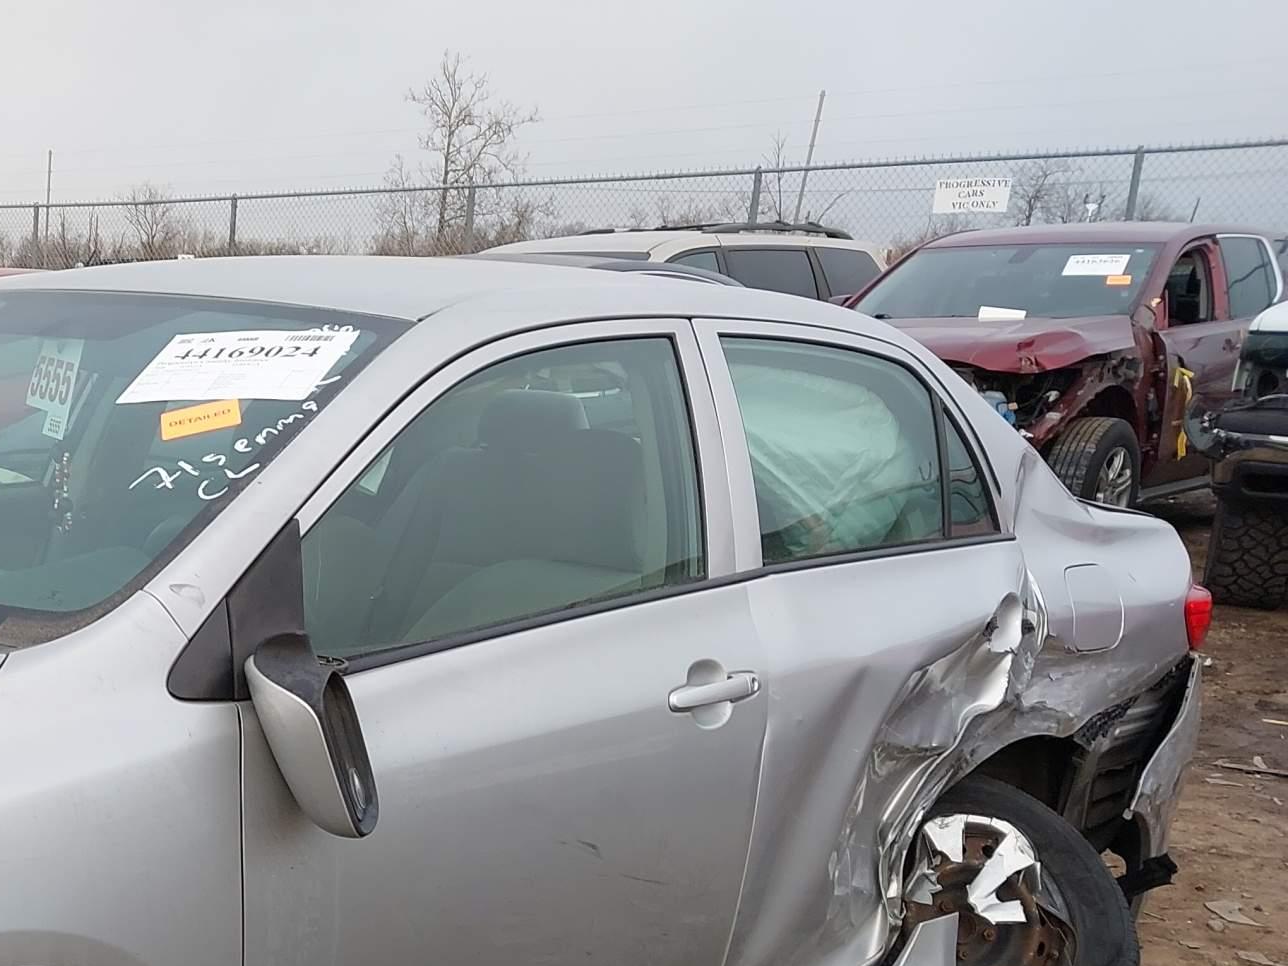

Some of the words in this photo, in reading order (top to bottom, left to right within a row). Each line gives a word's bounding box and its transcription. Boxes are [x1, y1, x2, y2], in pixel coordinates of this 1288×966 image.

[939, 179, 1009, 189] PROGRESSIVE
[958, 190, 984, 198] CARS
[971, 200, 998, 208] ONLY
[174, 345, 321, 360] 44169024
[168, 408, 231, 427] DETAILED
